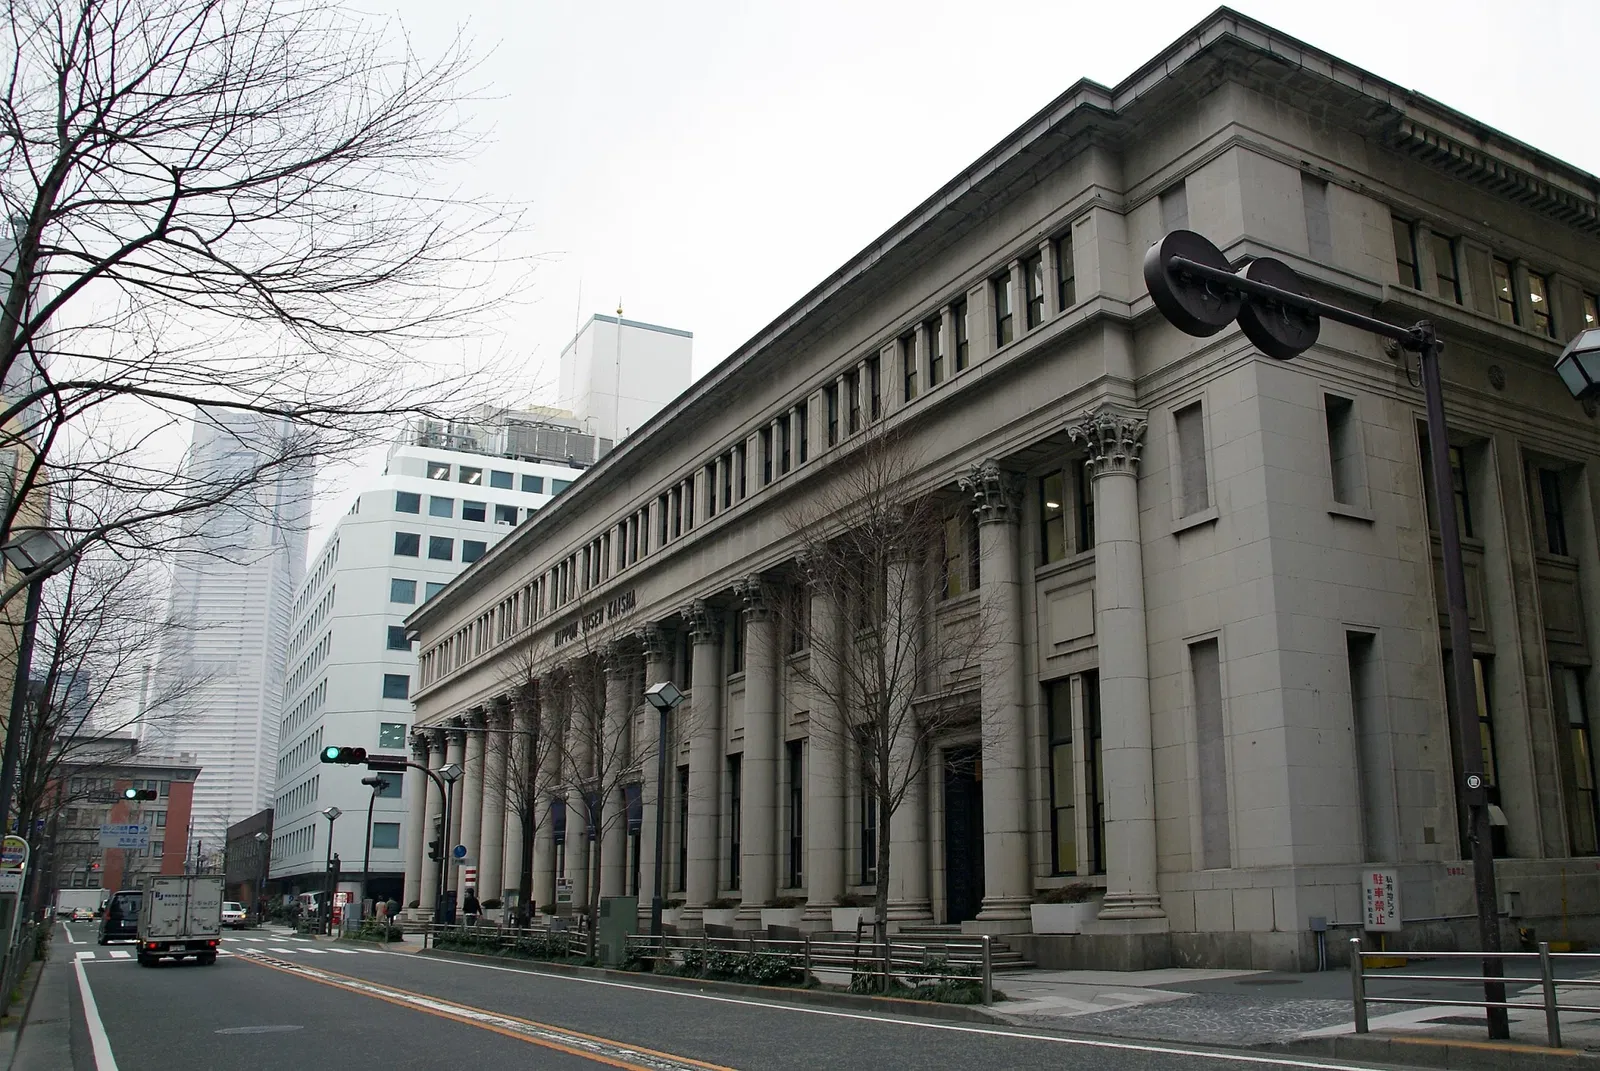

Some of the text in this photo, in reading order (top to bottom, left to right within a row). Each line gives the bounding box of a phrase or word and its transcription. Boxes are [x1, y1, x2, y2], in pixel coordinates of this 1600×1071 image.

[554, 590, 636, 648] NIPPON YUSEN KAISHA
[1373, 873, 1385, 925] 駐車禁止
[1386, 876, 1394, 918] 私有地につき
